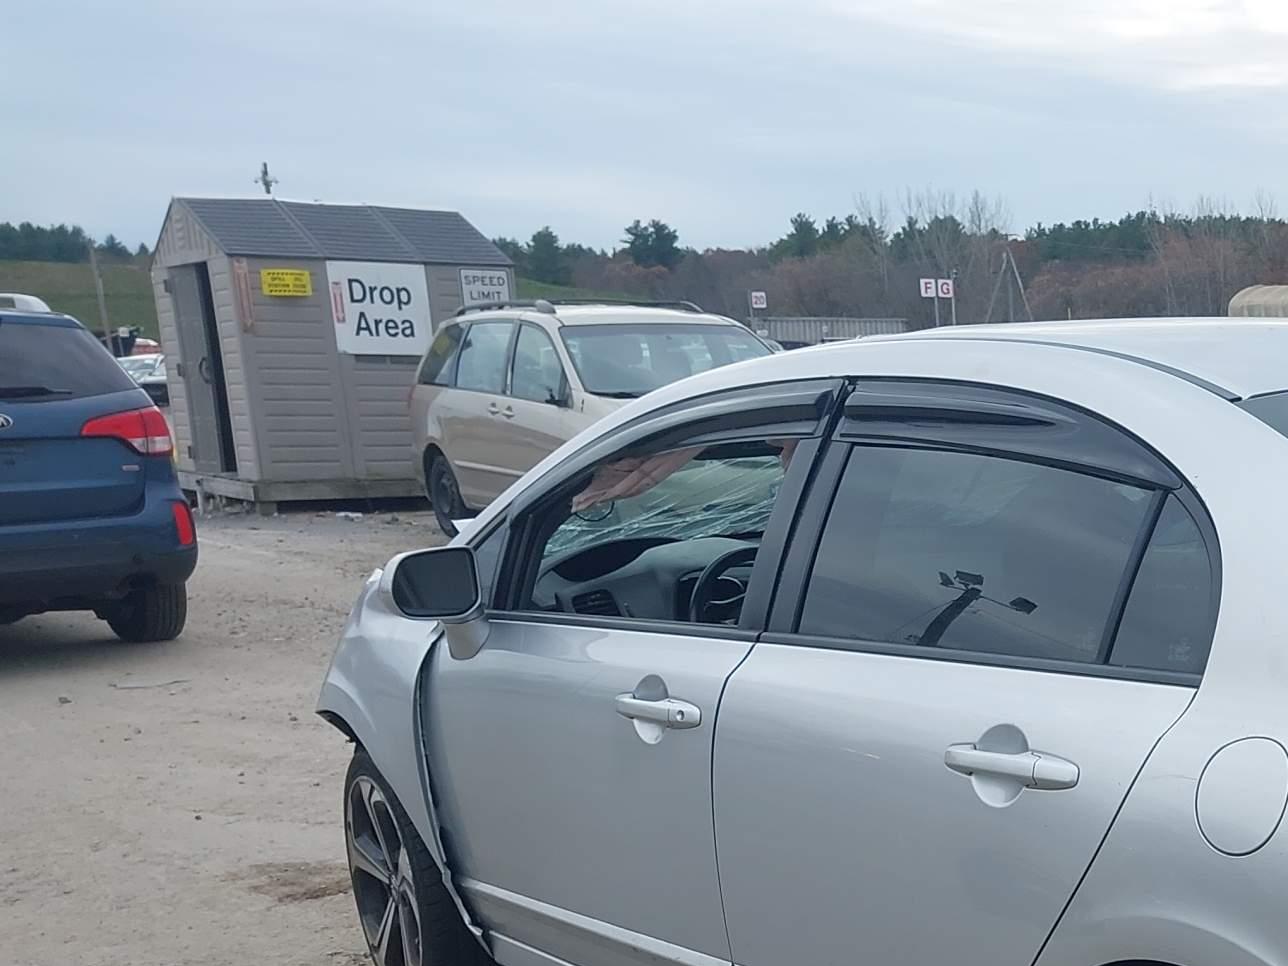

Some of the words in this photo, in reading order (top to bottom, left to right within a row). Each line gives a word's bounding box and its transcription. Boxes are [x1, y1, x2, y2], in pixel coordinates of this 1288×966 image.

[464, 275, 505, 287] SPEED
[347, 278, 412, 310] Drop
[924, 281, 932, 295] F
[940, 282, 951, 295] G
[470, 291, 502, 301] LIMIT
[355, 312, 416, 338] Area
